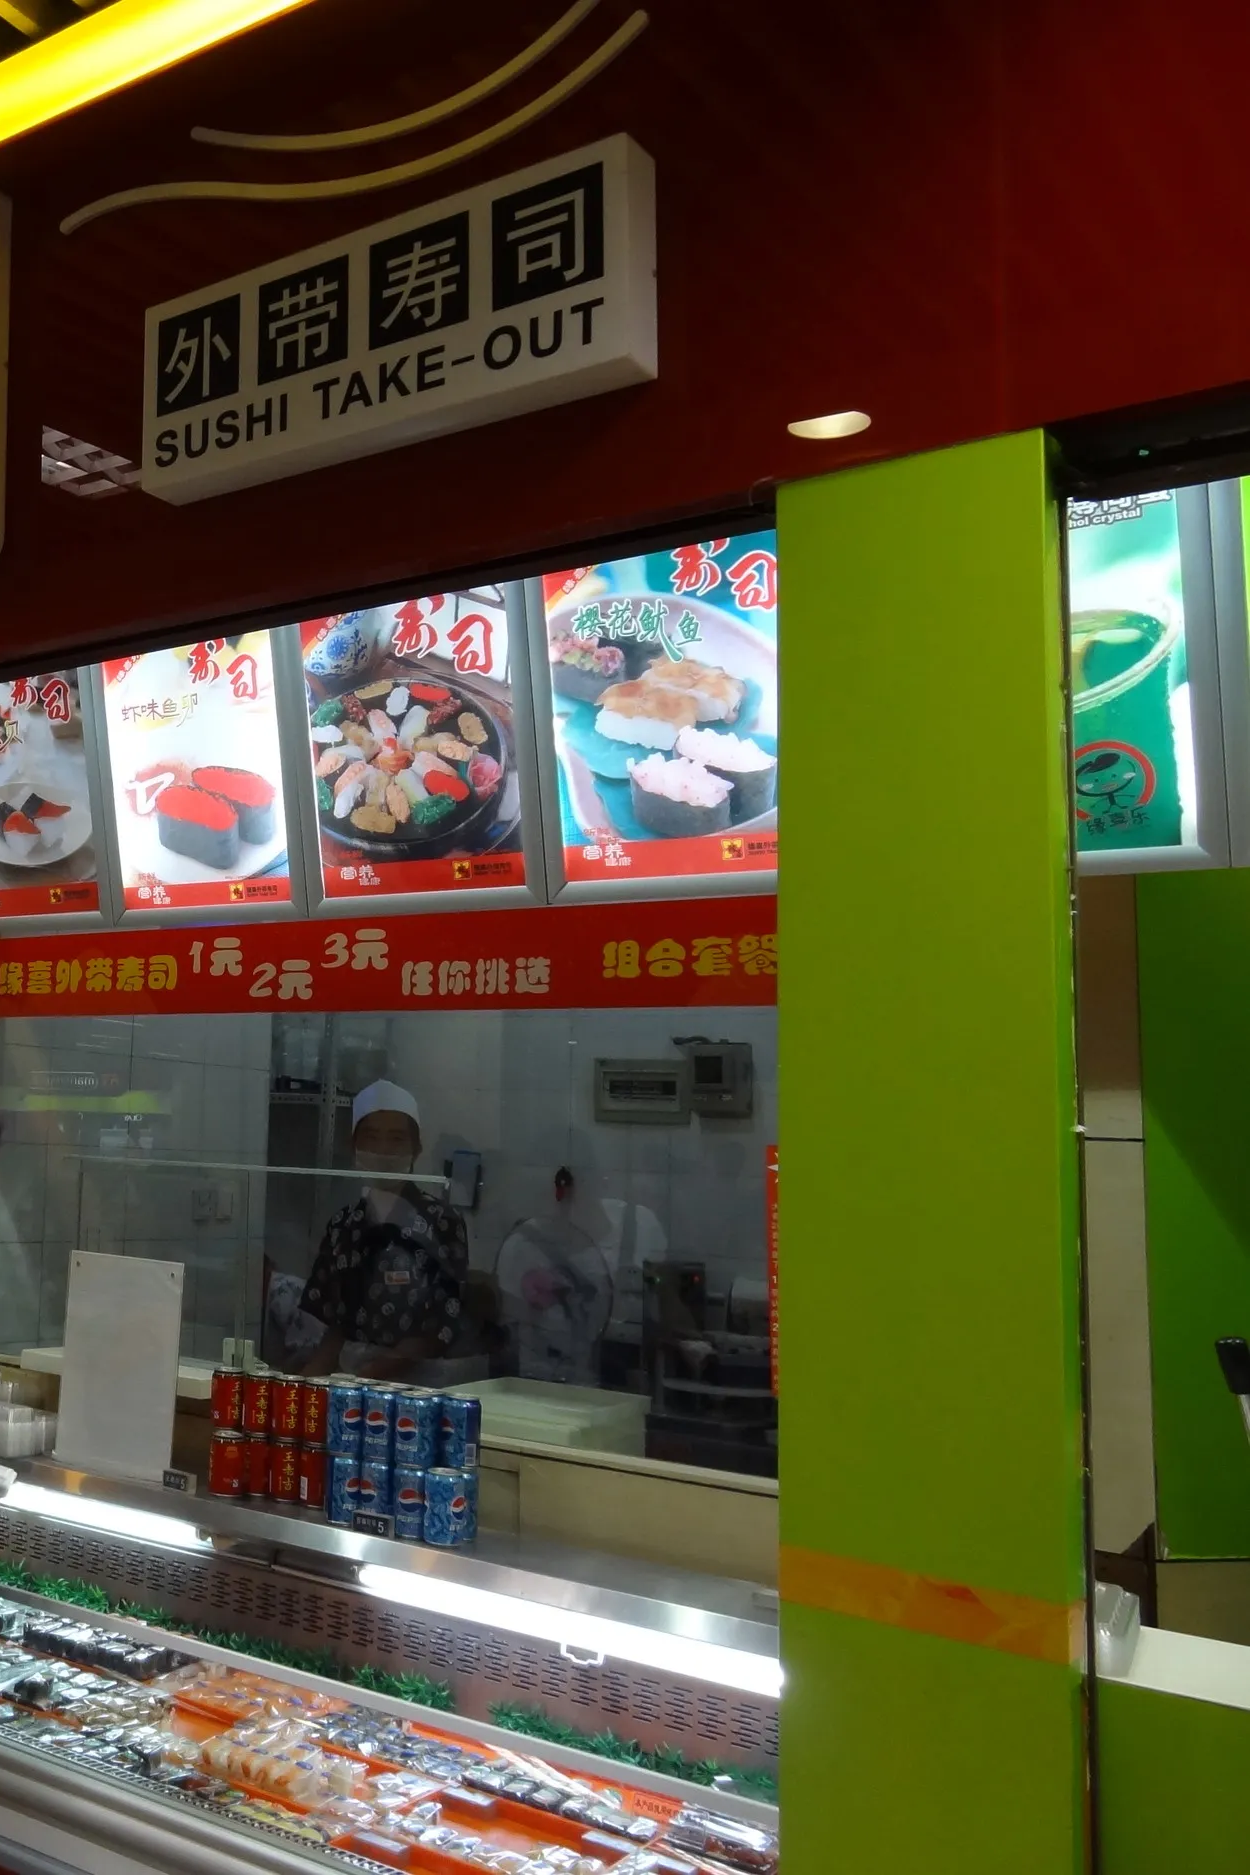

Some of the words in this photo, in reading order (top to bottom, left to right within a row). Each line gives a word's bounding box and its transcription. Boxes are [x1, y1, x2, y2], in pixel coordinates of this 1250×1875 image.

[162, 186, 587, 406] 外带寿司
[154, 393, 288, 468] SUSHI
[312, 298, 605, 420] TAKE-OUT
[1092, 507, 1142, 525] crystal
[188, 936, 243, 977] 1元
[248, 958, 313, 1001] 2元
[320, 928, 389, 971] 3元
[401, 956, 551, 997] 任你挑选
[601, 933, 778, 979] 组合套餐
[256, 1385, 269, 1424] 王老吉
[286, 1389, 299, 1429] 王老吉
[307, 1392, 319, 1433] 王老吉
[283, 1451, 295, 1491] 王老吉
[378, 1521, 385, 1534] 5
